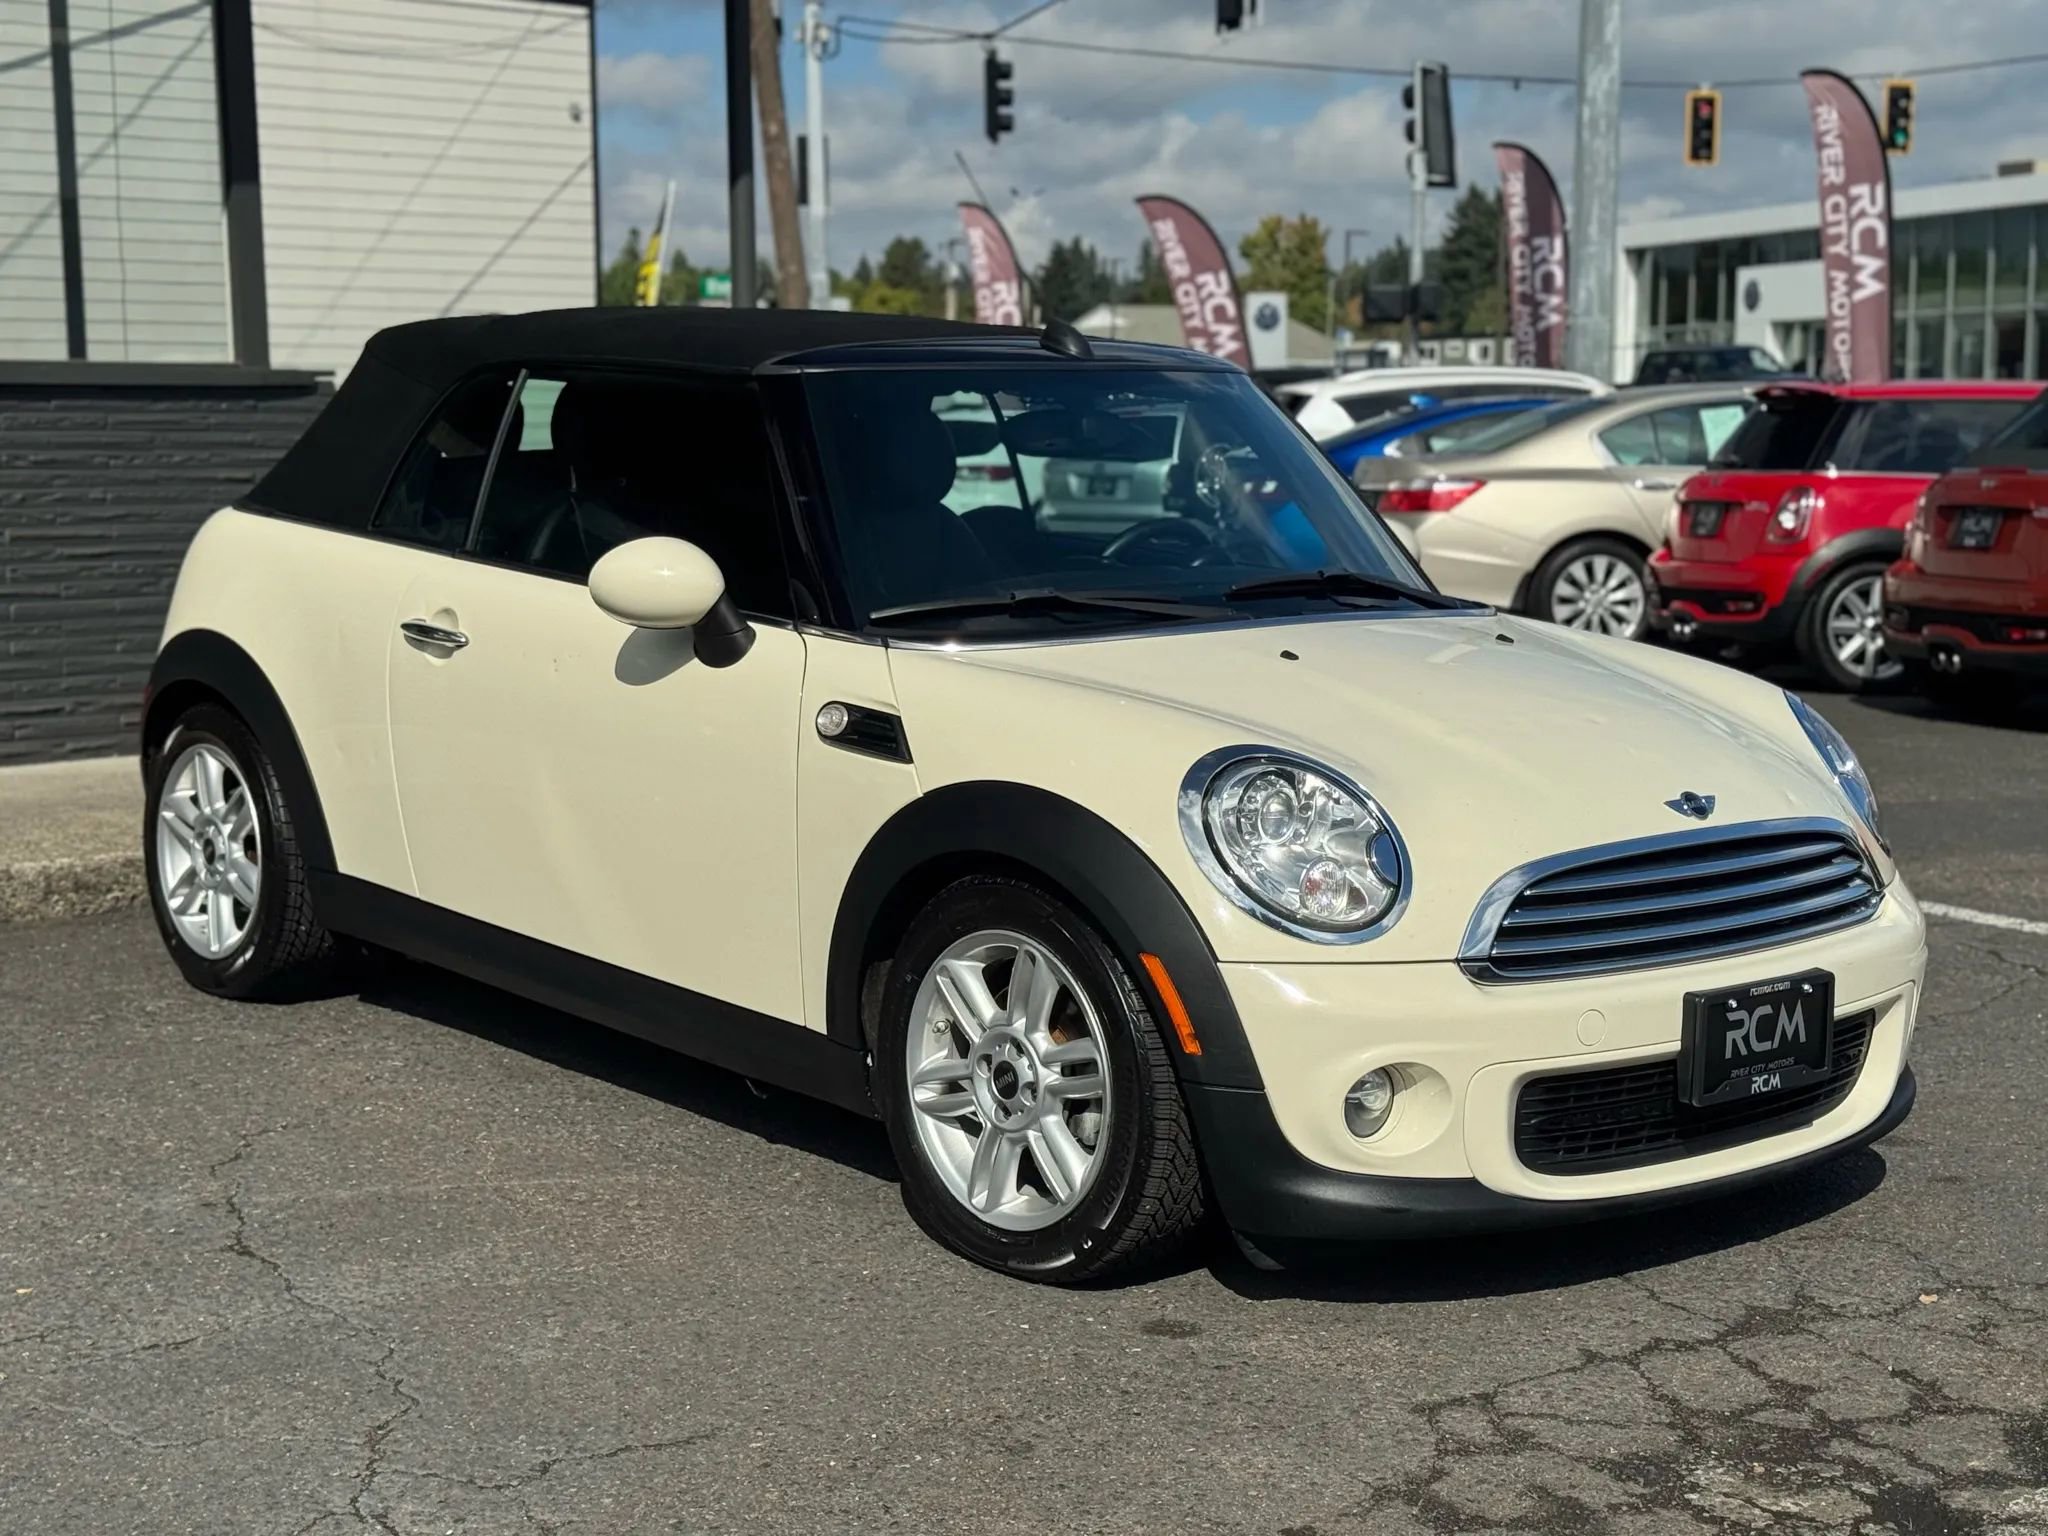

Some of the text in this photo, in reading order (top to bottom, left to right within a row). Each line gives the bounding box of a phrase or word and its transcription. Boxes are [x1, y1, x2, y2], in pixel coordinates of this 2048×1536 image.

[1814, 100, 1846, 187] RIVER
[1823, 193, 1849, 257] CITY
[1849, 182, 1885, 302] RCM
[1195, 269, 1242, 357] RCM
[1531, 236, 1565, 332] RCM
[1725, 1000, 1806, 1059] RCM
[995, 1071, 1015, 1089] MINI
[1730, 1056, 1795, 1079] RIVER CITY MOTORS
[1751, 1072, 1781, 1094] RCM
